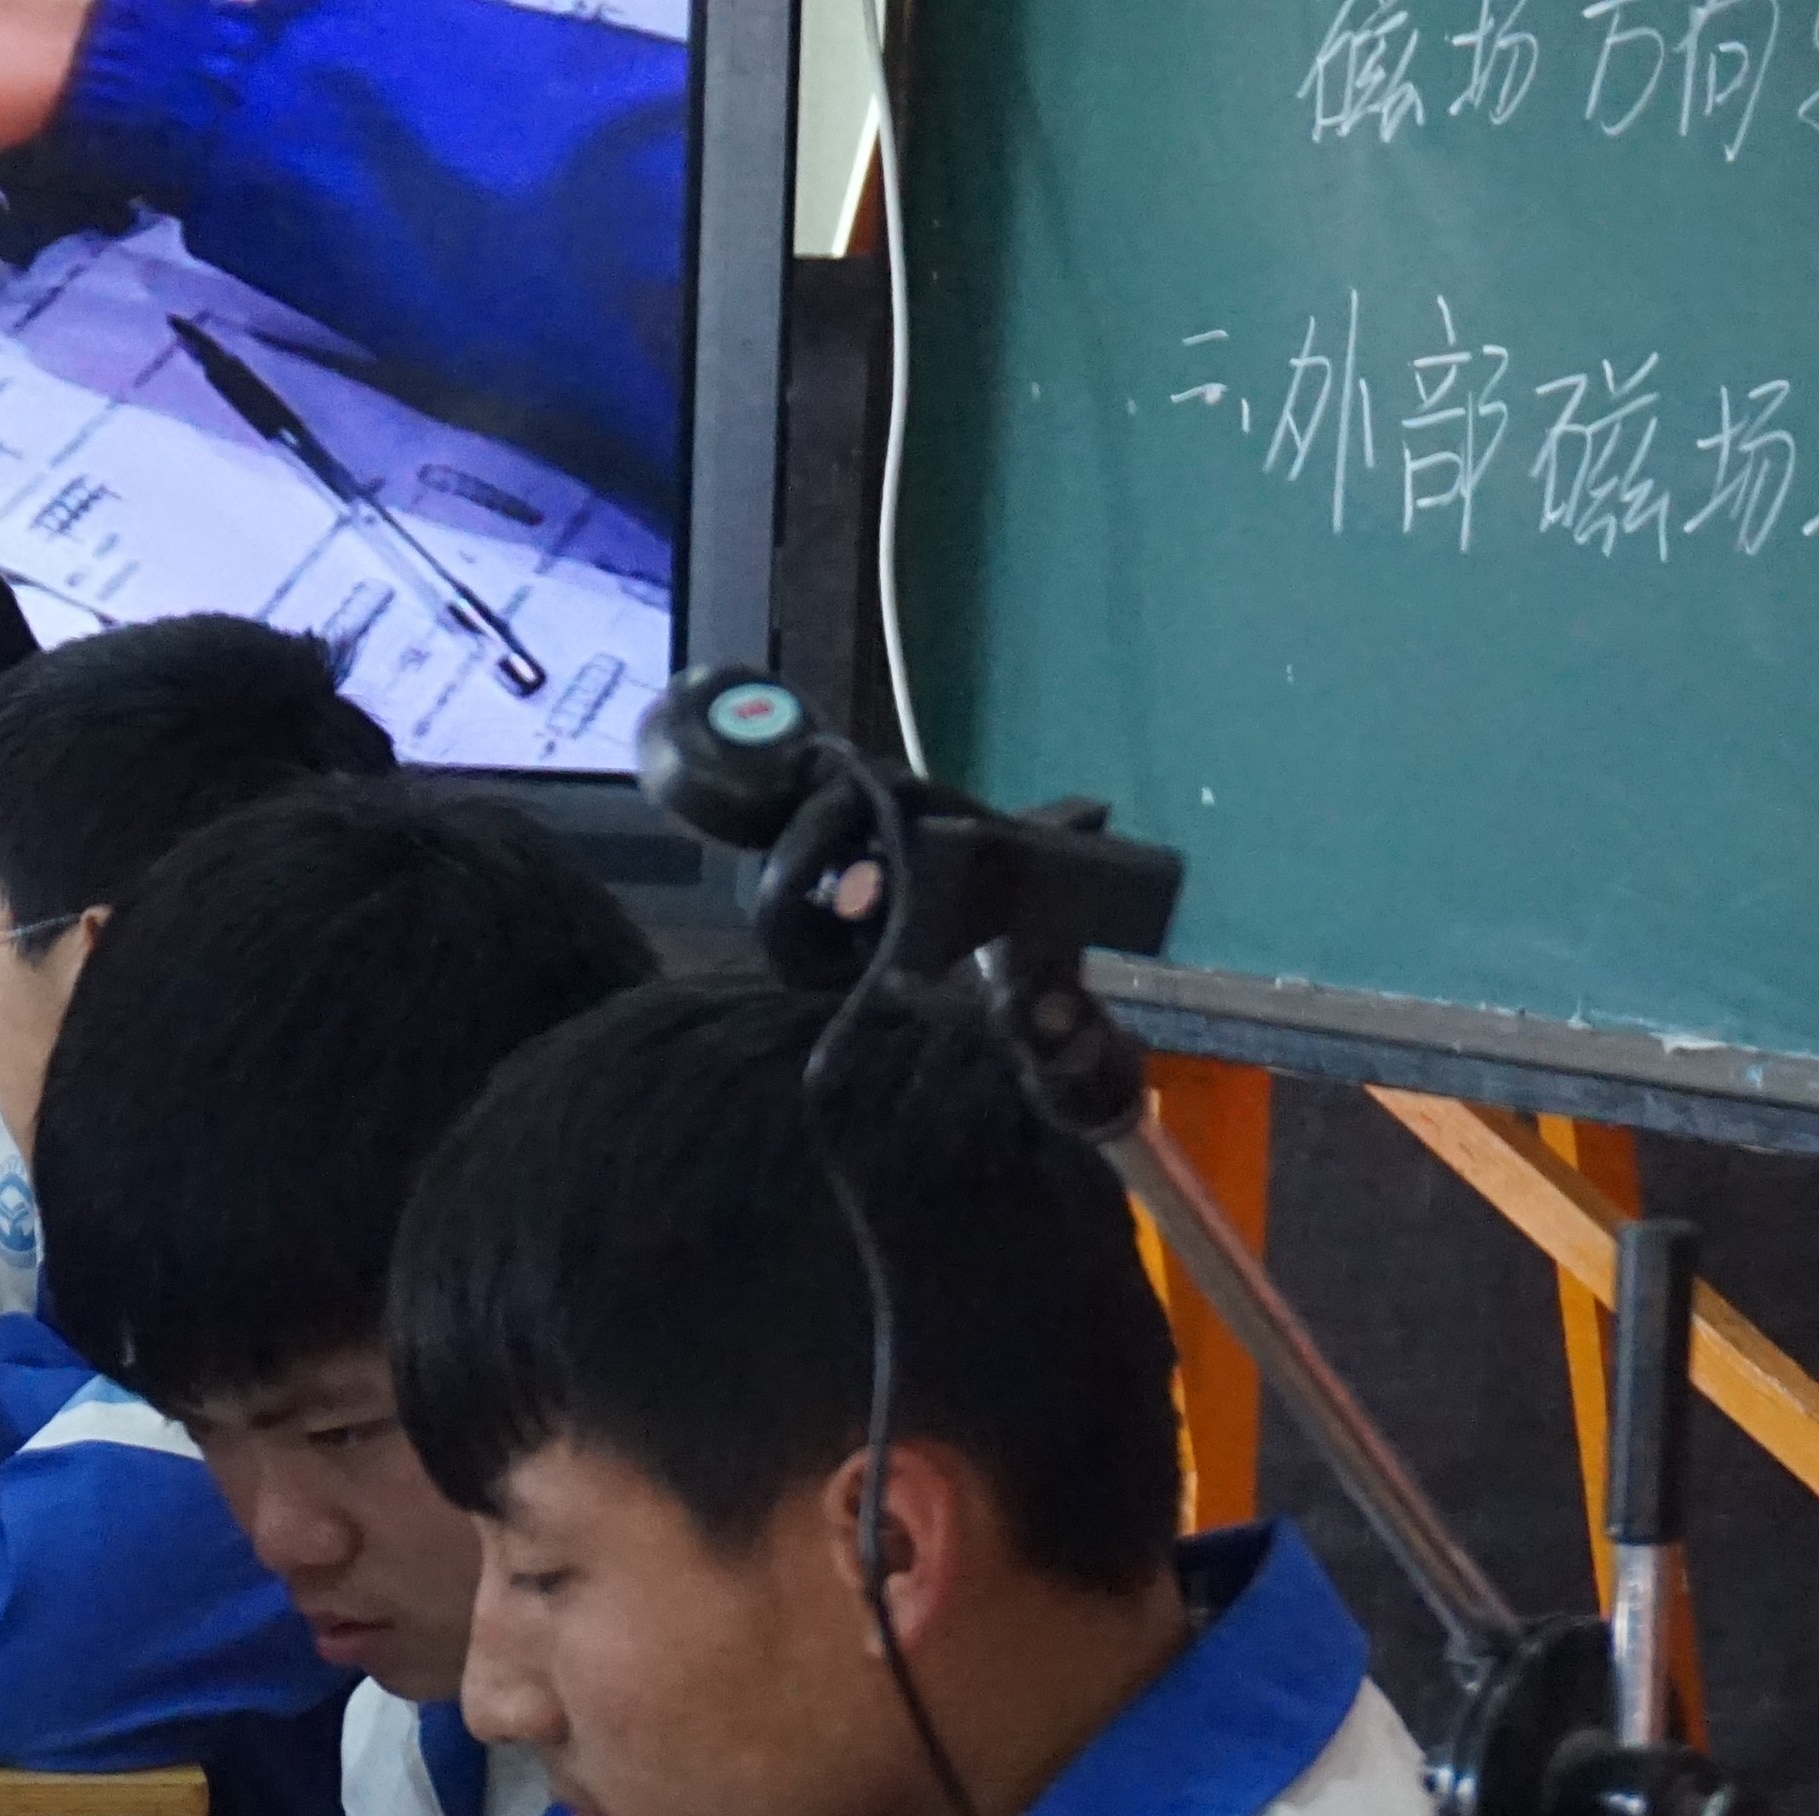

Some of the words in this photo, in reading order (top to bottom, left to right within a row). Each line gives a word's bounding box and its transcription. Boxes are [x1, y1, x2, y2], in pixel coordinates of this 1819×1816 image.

[1297, 0, 1819, 162] 磁场方向
[1169, 288, 1819, 563] 二、外部磁场
